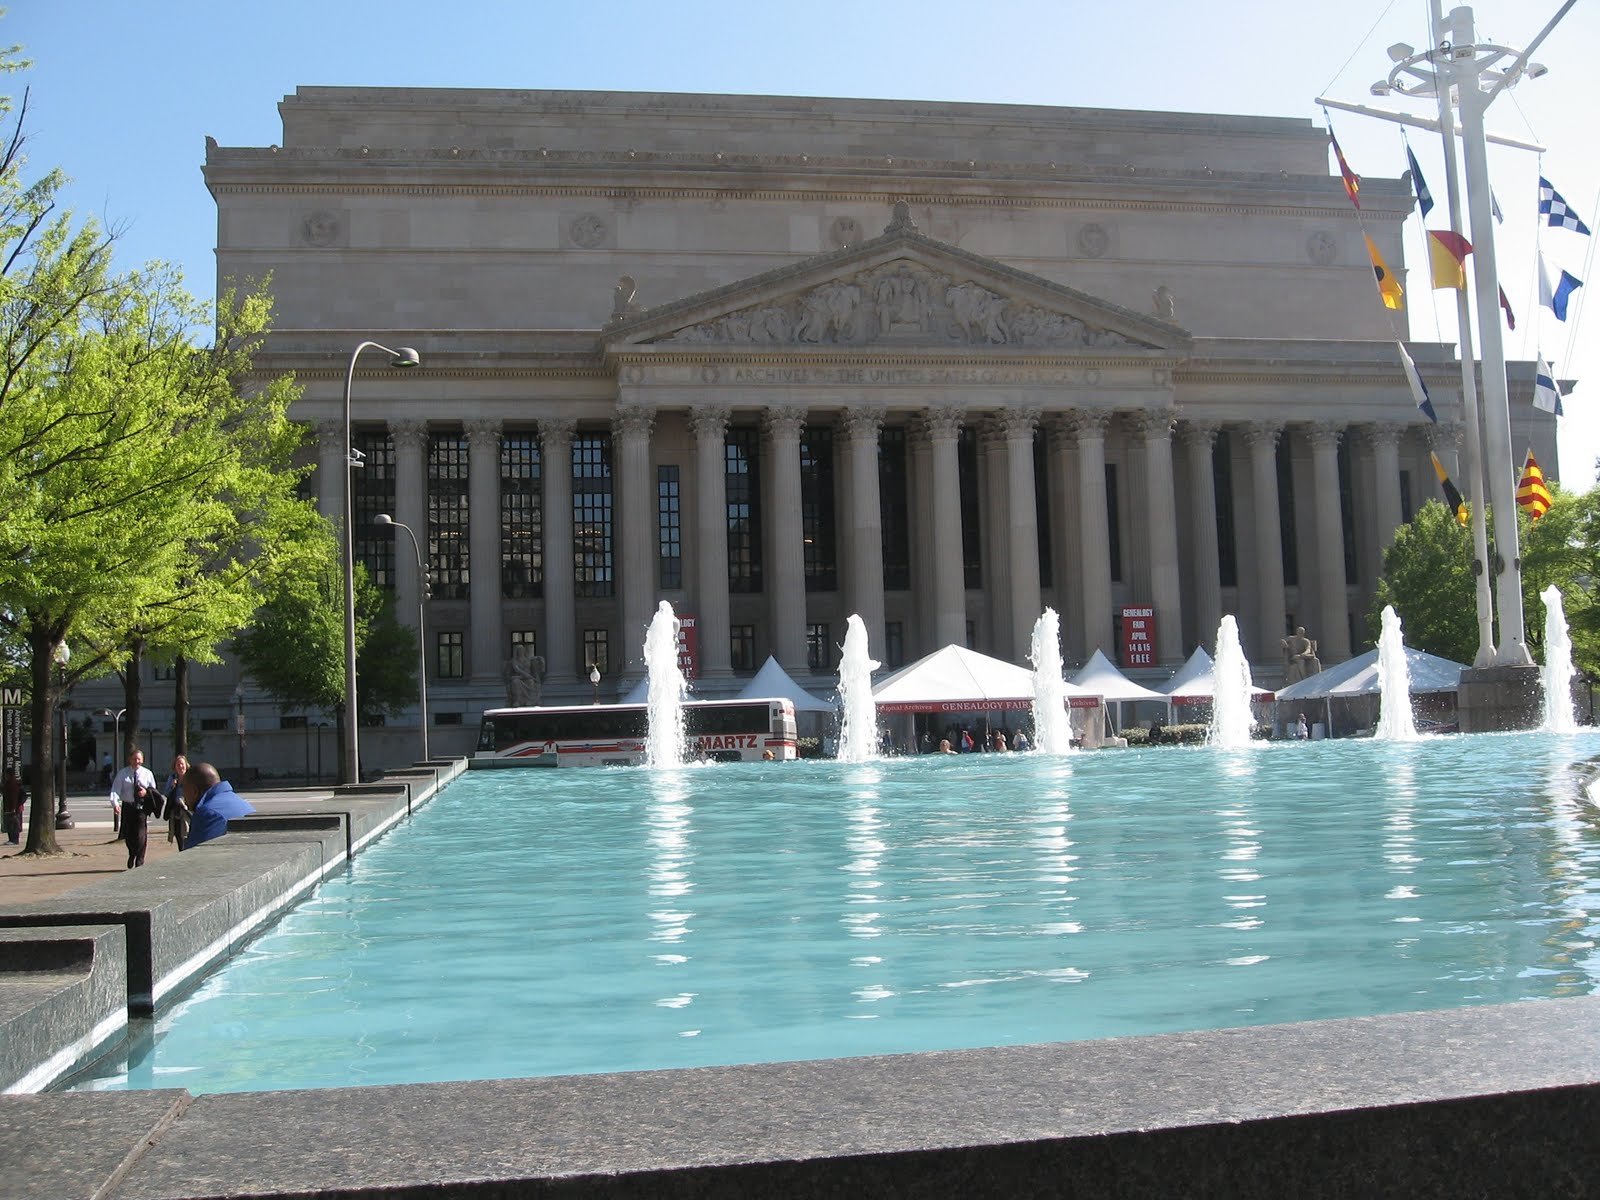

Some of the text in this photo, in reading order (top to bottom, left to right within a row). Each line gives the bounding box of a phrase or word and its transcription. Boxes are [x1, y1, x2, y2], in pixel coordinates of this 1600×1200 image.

[735, 368, 808, 383] ARCHIVES
[839, 368, 864, 383] THE
[1123, 608, 1153, 617] GENEALOGY
[1132, 620, 1145, 629] FAIR
[1131, 632, 1147, 640] APRIL
[1129, 643, 1136, 652] 14
[1143, 643, 1151, 652] 15
[1130, 654, 1150, 663] FREE
[4, 688, 21, 705] M
[942, 702, 1003, 711] GENEALOGY
[1006, 701, 1029, 709] FAIR
[6, 709, 14, 726] Penn
[6, 728, 14, 754] Quarter
[698, 735, 757, 750] MARTZ
